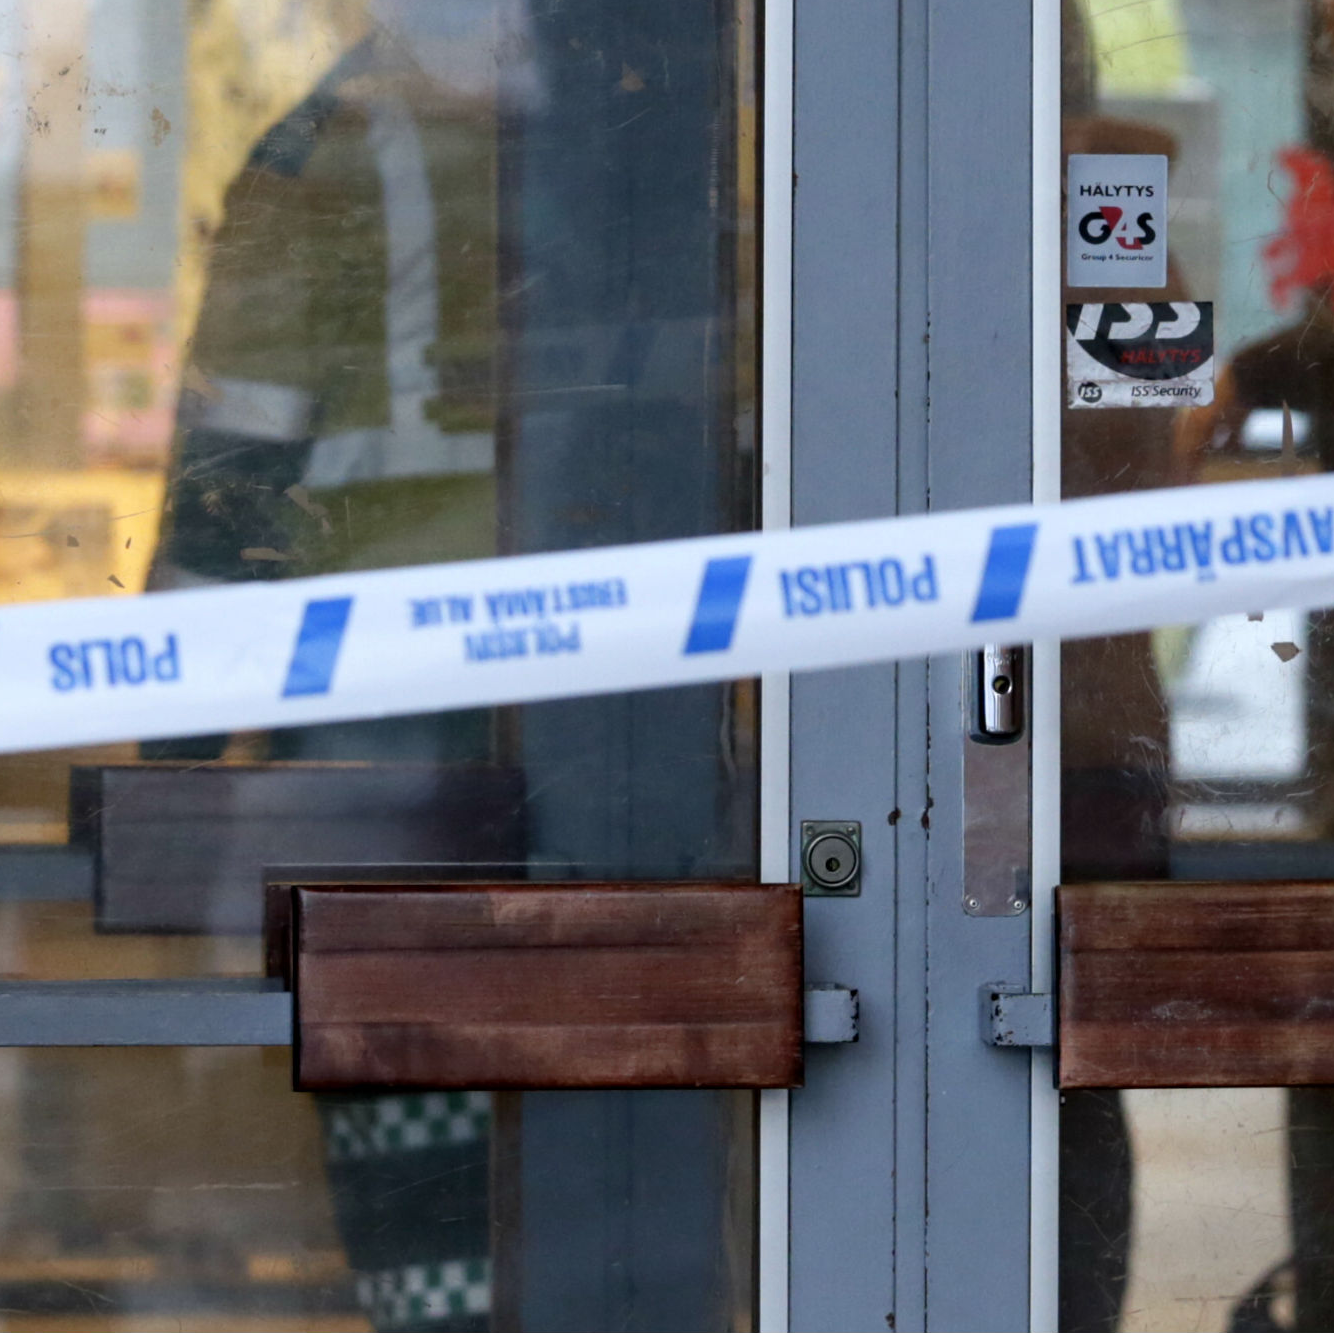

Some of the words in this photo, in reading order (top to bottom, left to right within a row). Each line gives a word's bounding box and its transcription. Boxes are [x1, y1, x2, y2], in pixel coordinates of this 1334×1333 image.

[1079, 182, 1155, 197] HÄLYTYS
[1078, 206, 1157, 250] G4S
[1081, 253, 1107, 263] Group
[1079, 386, 1101, 399] ISS
[1131, 385, 1149, 397] ISS
[1152, 384, 1203, 399] Security
[779, 555, 941, 619] POLIISI
[408, 597, 470, 629] ALUE
[49, 633, 179, 693] POLIS
